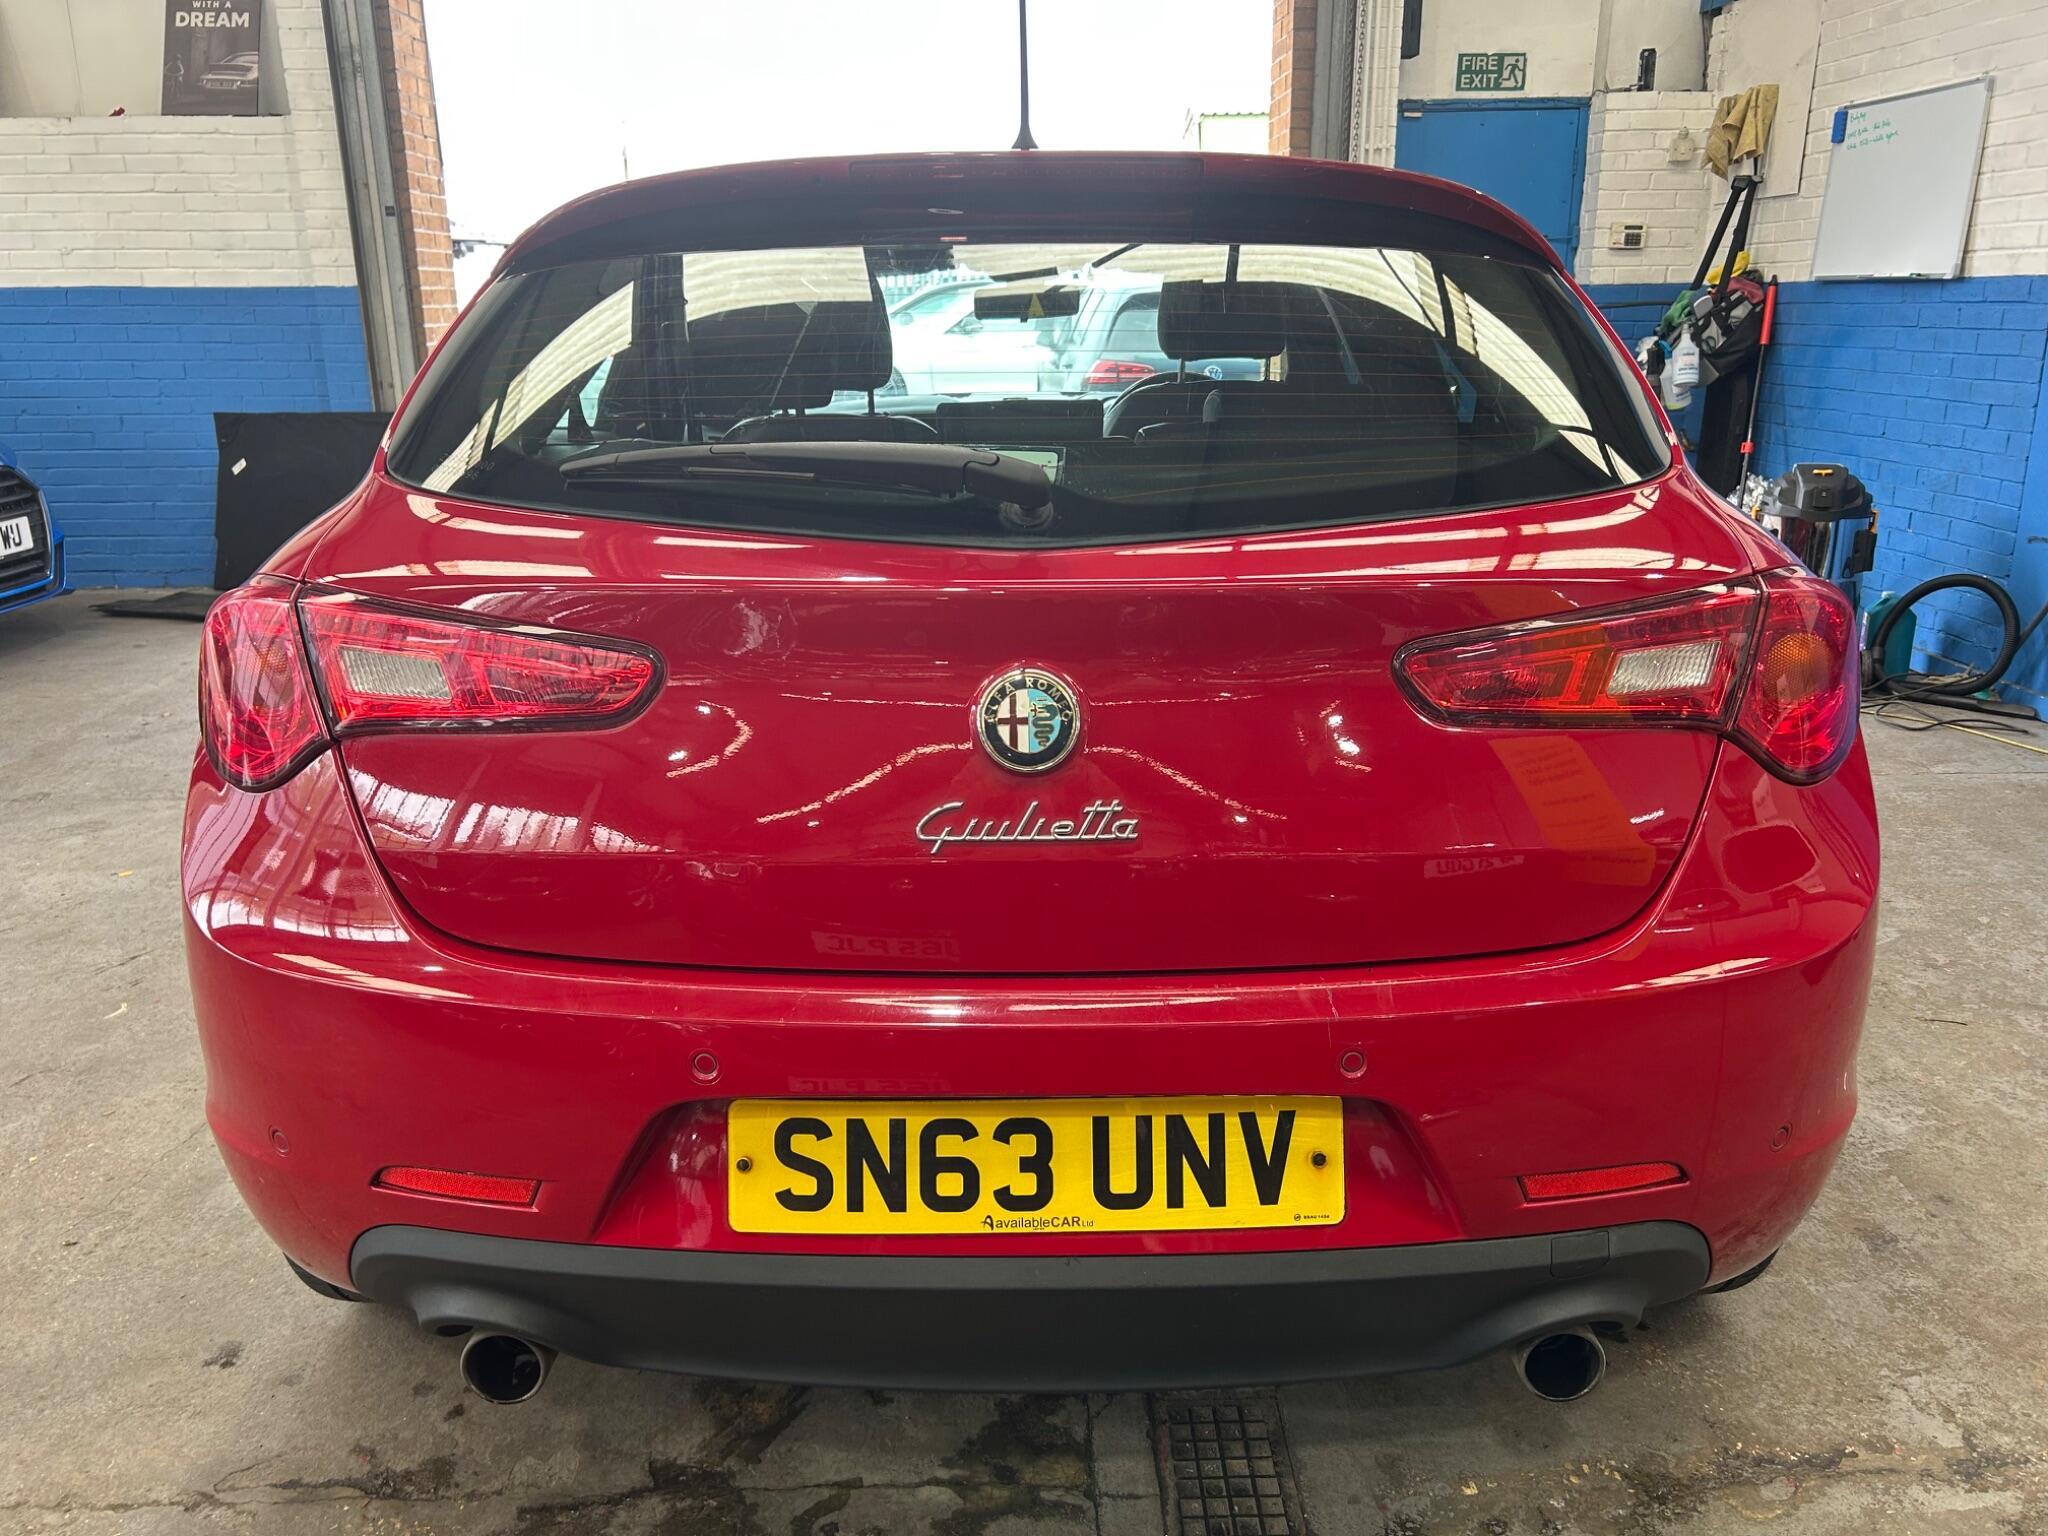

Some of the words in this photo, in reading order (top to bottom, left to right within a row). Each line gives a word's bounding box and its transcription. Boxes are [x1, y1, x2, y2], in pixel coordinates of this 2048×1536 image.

[192, 0, 220, 8] WITH
[175, 11, 250, 28] DREAM
[1462, 56, 1498, 71] FIRE
[1460, 74, 1498, 88] EXIT
[984, 682, 1015, 723] ALFA
[1025, 677, 1072, 721] ROMEO
[916, 800, 1139, 854] Giulietta
[774, 1117, 1054, 1213] SN63
[1092, 1110, 1297, 1210] UNV
